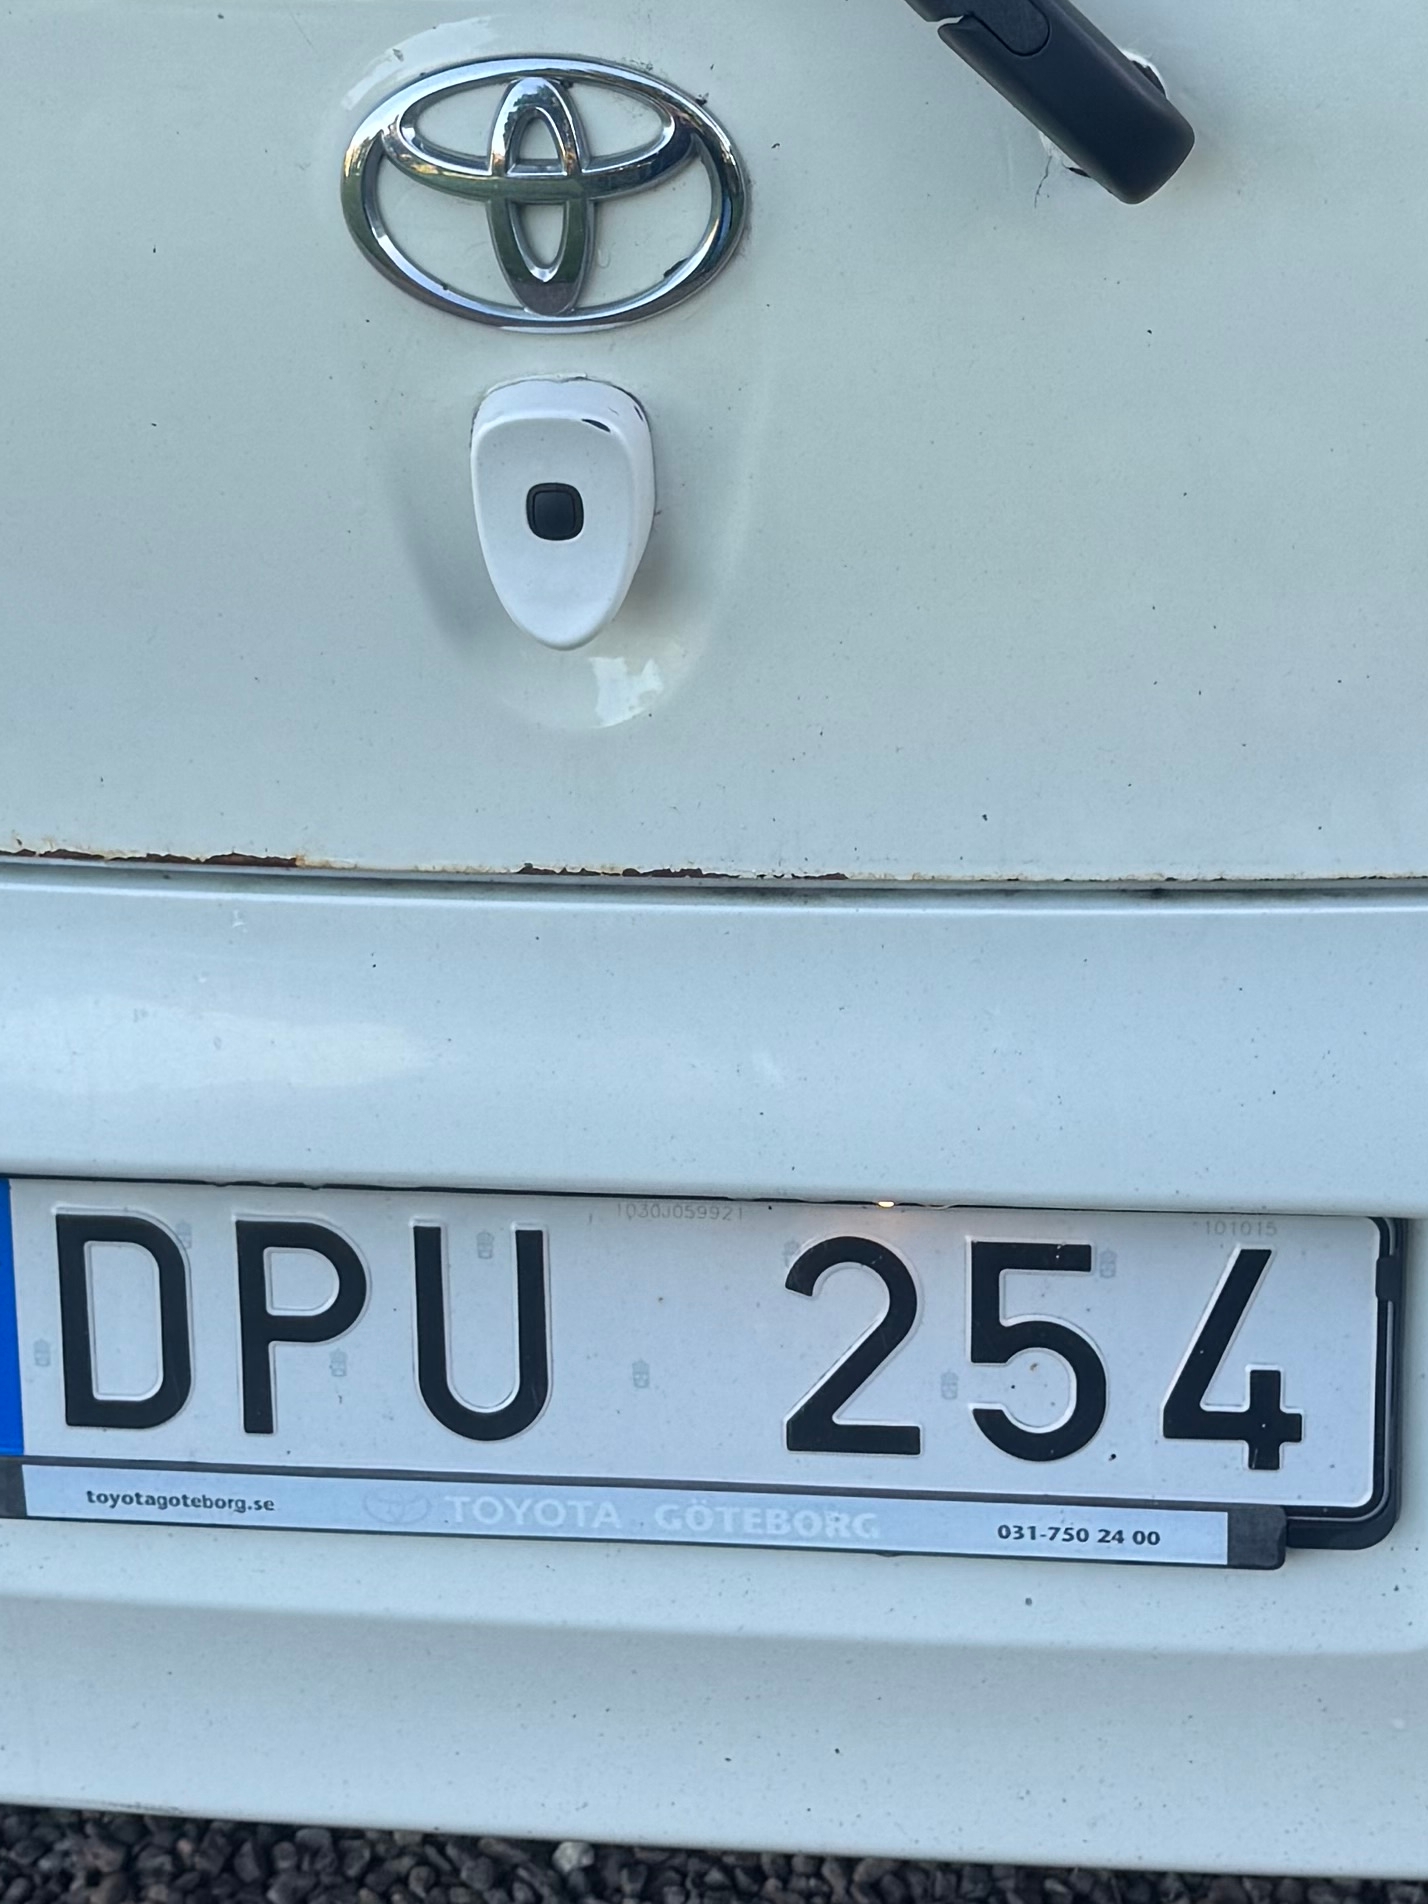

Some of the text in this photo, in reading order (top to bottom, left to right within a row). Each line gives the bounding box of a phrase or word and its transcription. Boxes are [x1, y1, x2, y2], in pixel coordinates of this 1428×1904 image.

[55, 1214, 1304, 1472] DPU 254
[85, 1489, 275, 1513] toyotagoteborg.se
[444, 1495, 880, 1541] TOYOTA GÖTEBORG
[997, 1523, 1161, 1547] 031-750 24 00
